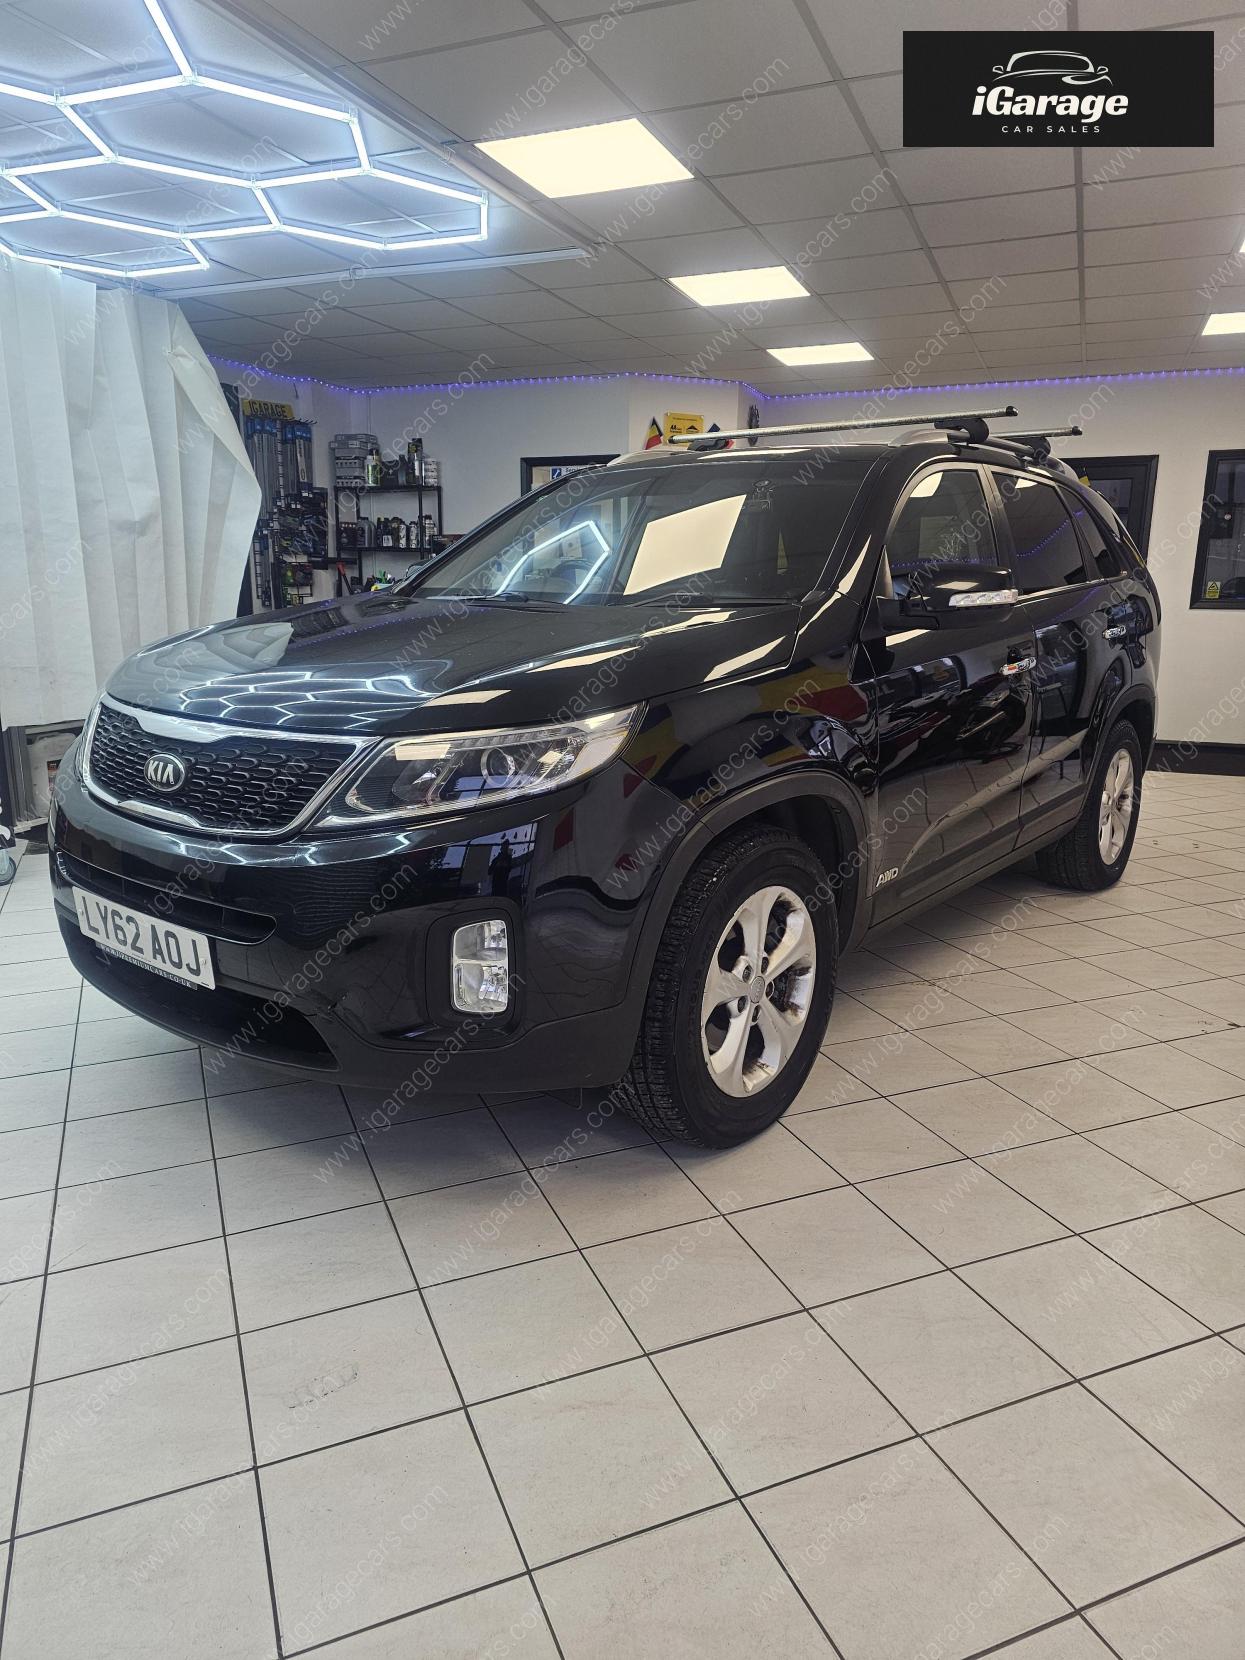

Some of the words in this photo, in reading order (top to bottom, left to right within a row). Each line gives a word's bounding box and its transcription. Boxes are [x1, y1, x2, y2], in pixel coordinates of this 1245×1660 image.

[148, 760, 174, 784] KIA
[876, 867, 899, 888] AWD
[82, 896, 144, 955] LY62
[151, 924, 201, 977] AOJ
